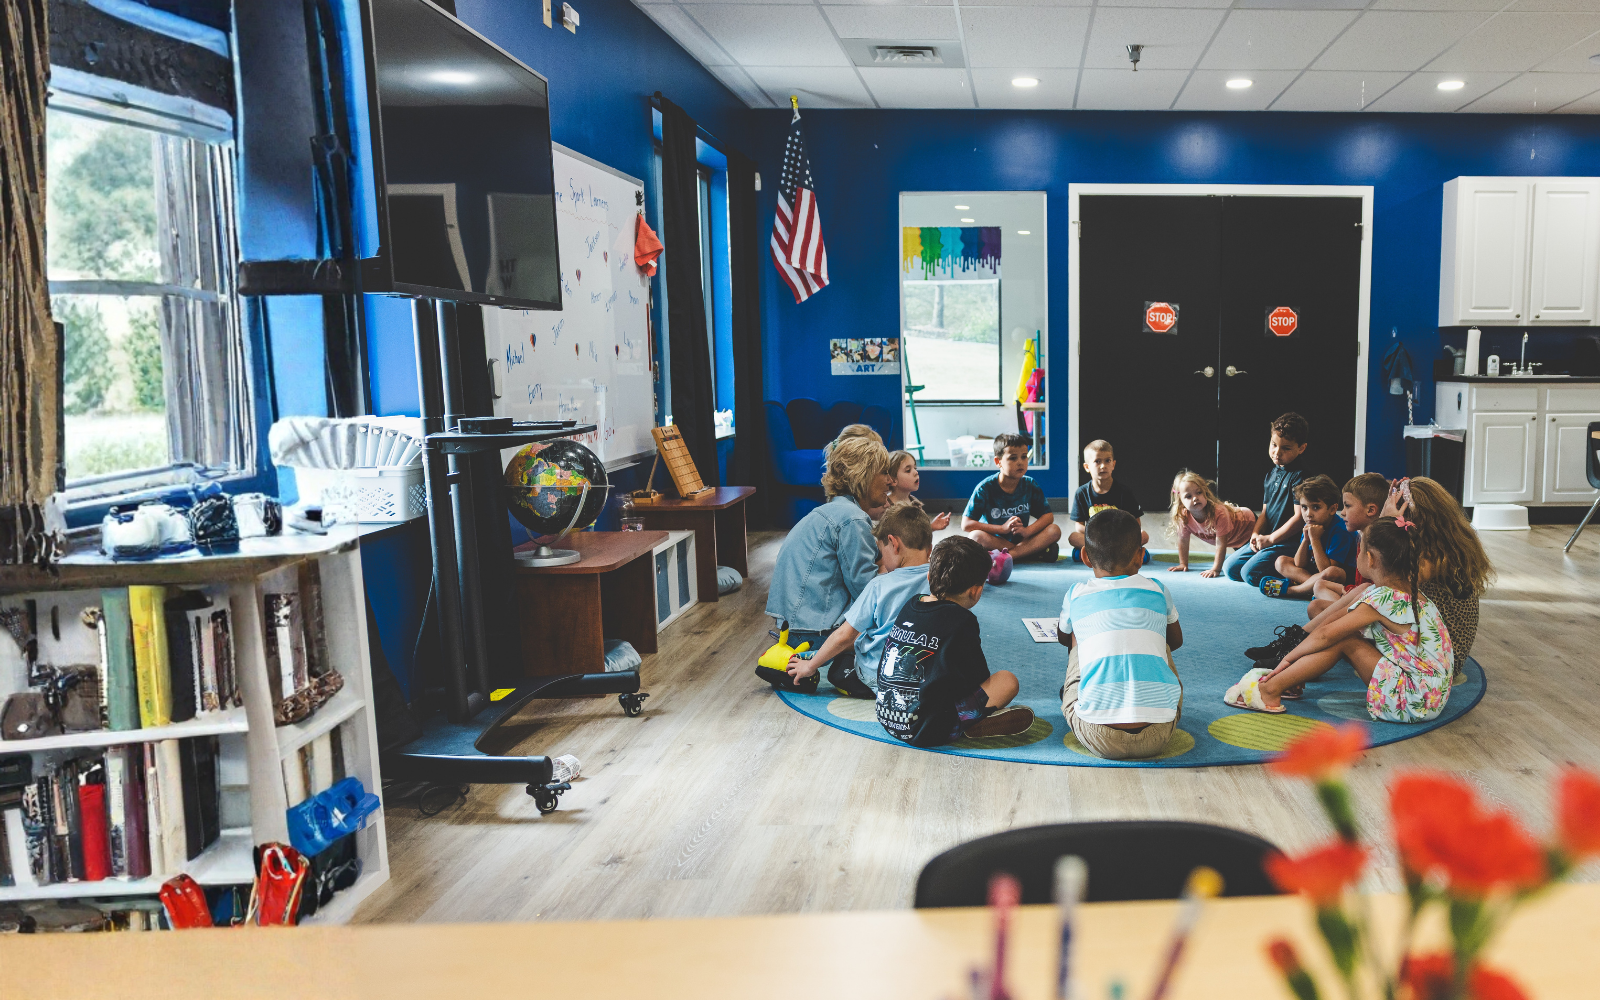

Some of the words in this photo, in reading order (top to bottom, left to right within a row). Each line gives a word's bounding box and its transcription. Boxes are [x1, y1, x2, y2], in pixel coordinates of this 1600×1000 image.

[1149, 312, 1173, 322] STOP
[1271, 316, 1295, 327] STOP
[855, 363, 876, 373] ART
[1001, 502, 1029, 517] ACTON
[927, 636, 939, 653] 1
